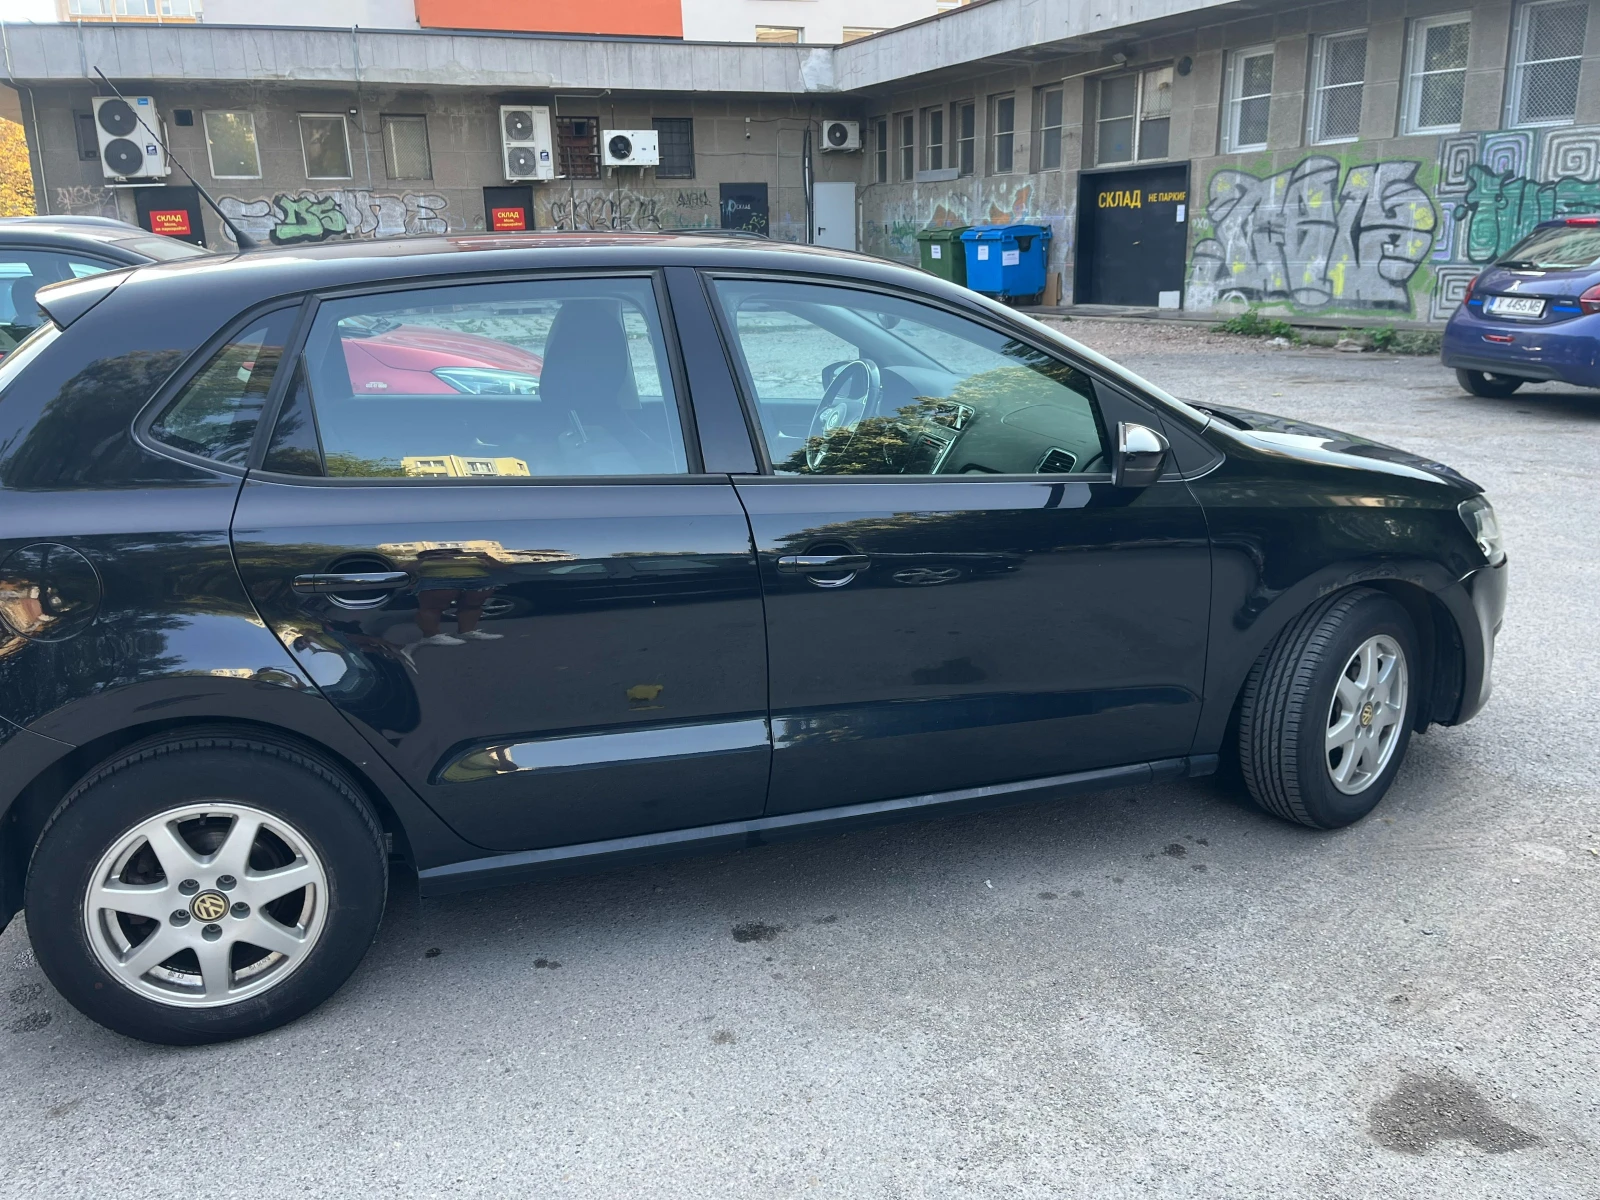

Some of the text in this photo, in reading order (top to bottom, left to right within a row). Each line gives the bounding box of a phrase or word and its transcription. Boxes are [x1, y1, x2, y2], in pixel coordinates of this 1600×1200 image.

[1098, 189, 1141, 209] СКЛАД
[1148, 193, 1158, 203] НЕ
[156, 214, 183, 222] СКЛАД
[497, 211, 520, 219] СКЛАД
